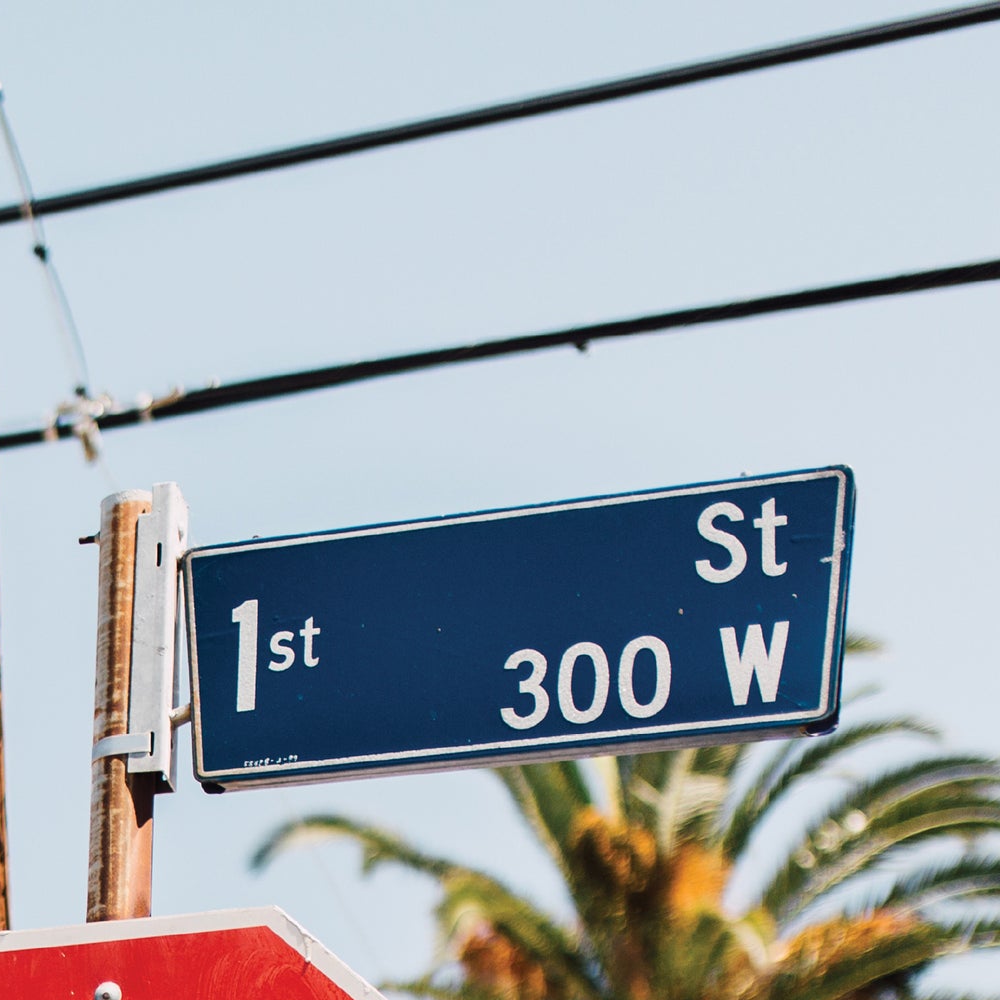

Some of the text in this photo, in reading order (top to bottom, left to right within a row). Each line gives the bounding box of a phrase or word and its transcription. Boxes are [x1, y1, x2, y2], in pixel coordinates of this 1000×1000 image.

[231, 498, 788, 712] 1st St
[500, 621, 790, 730] 300 W
